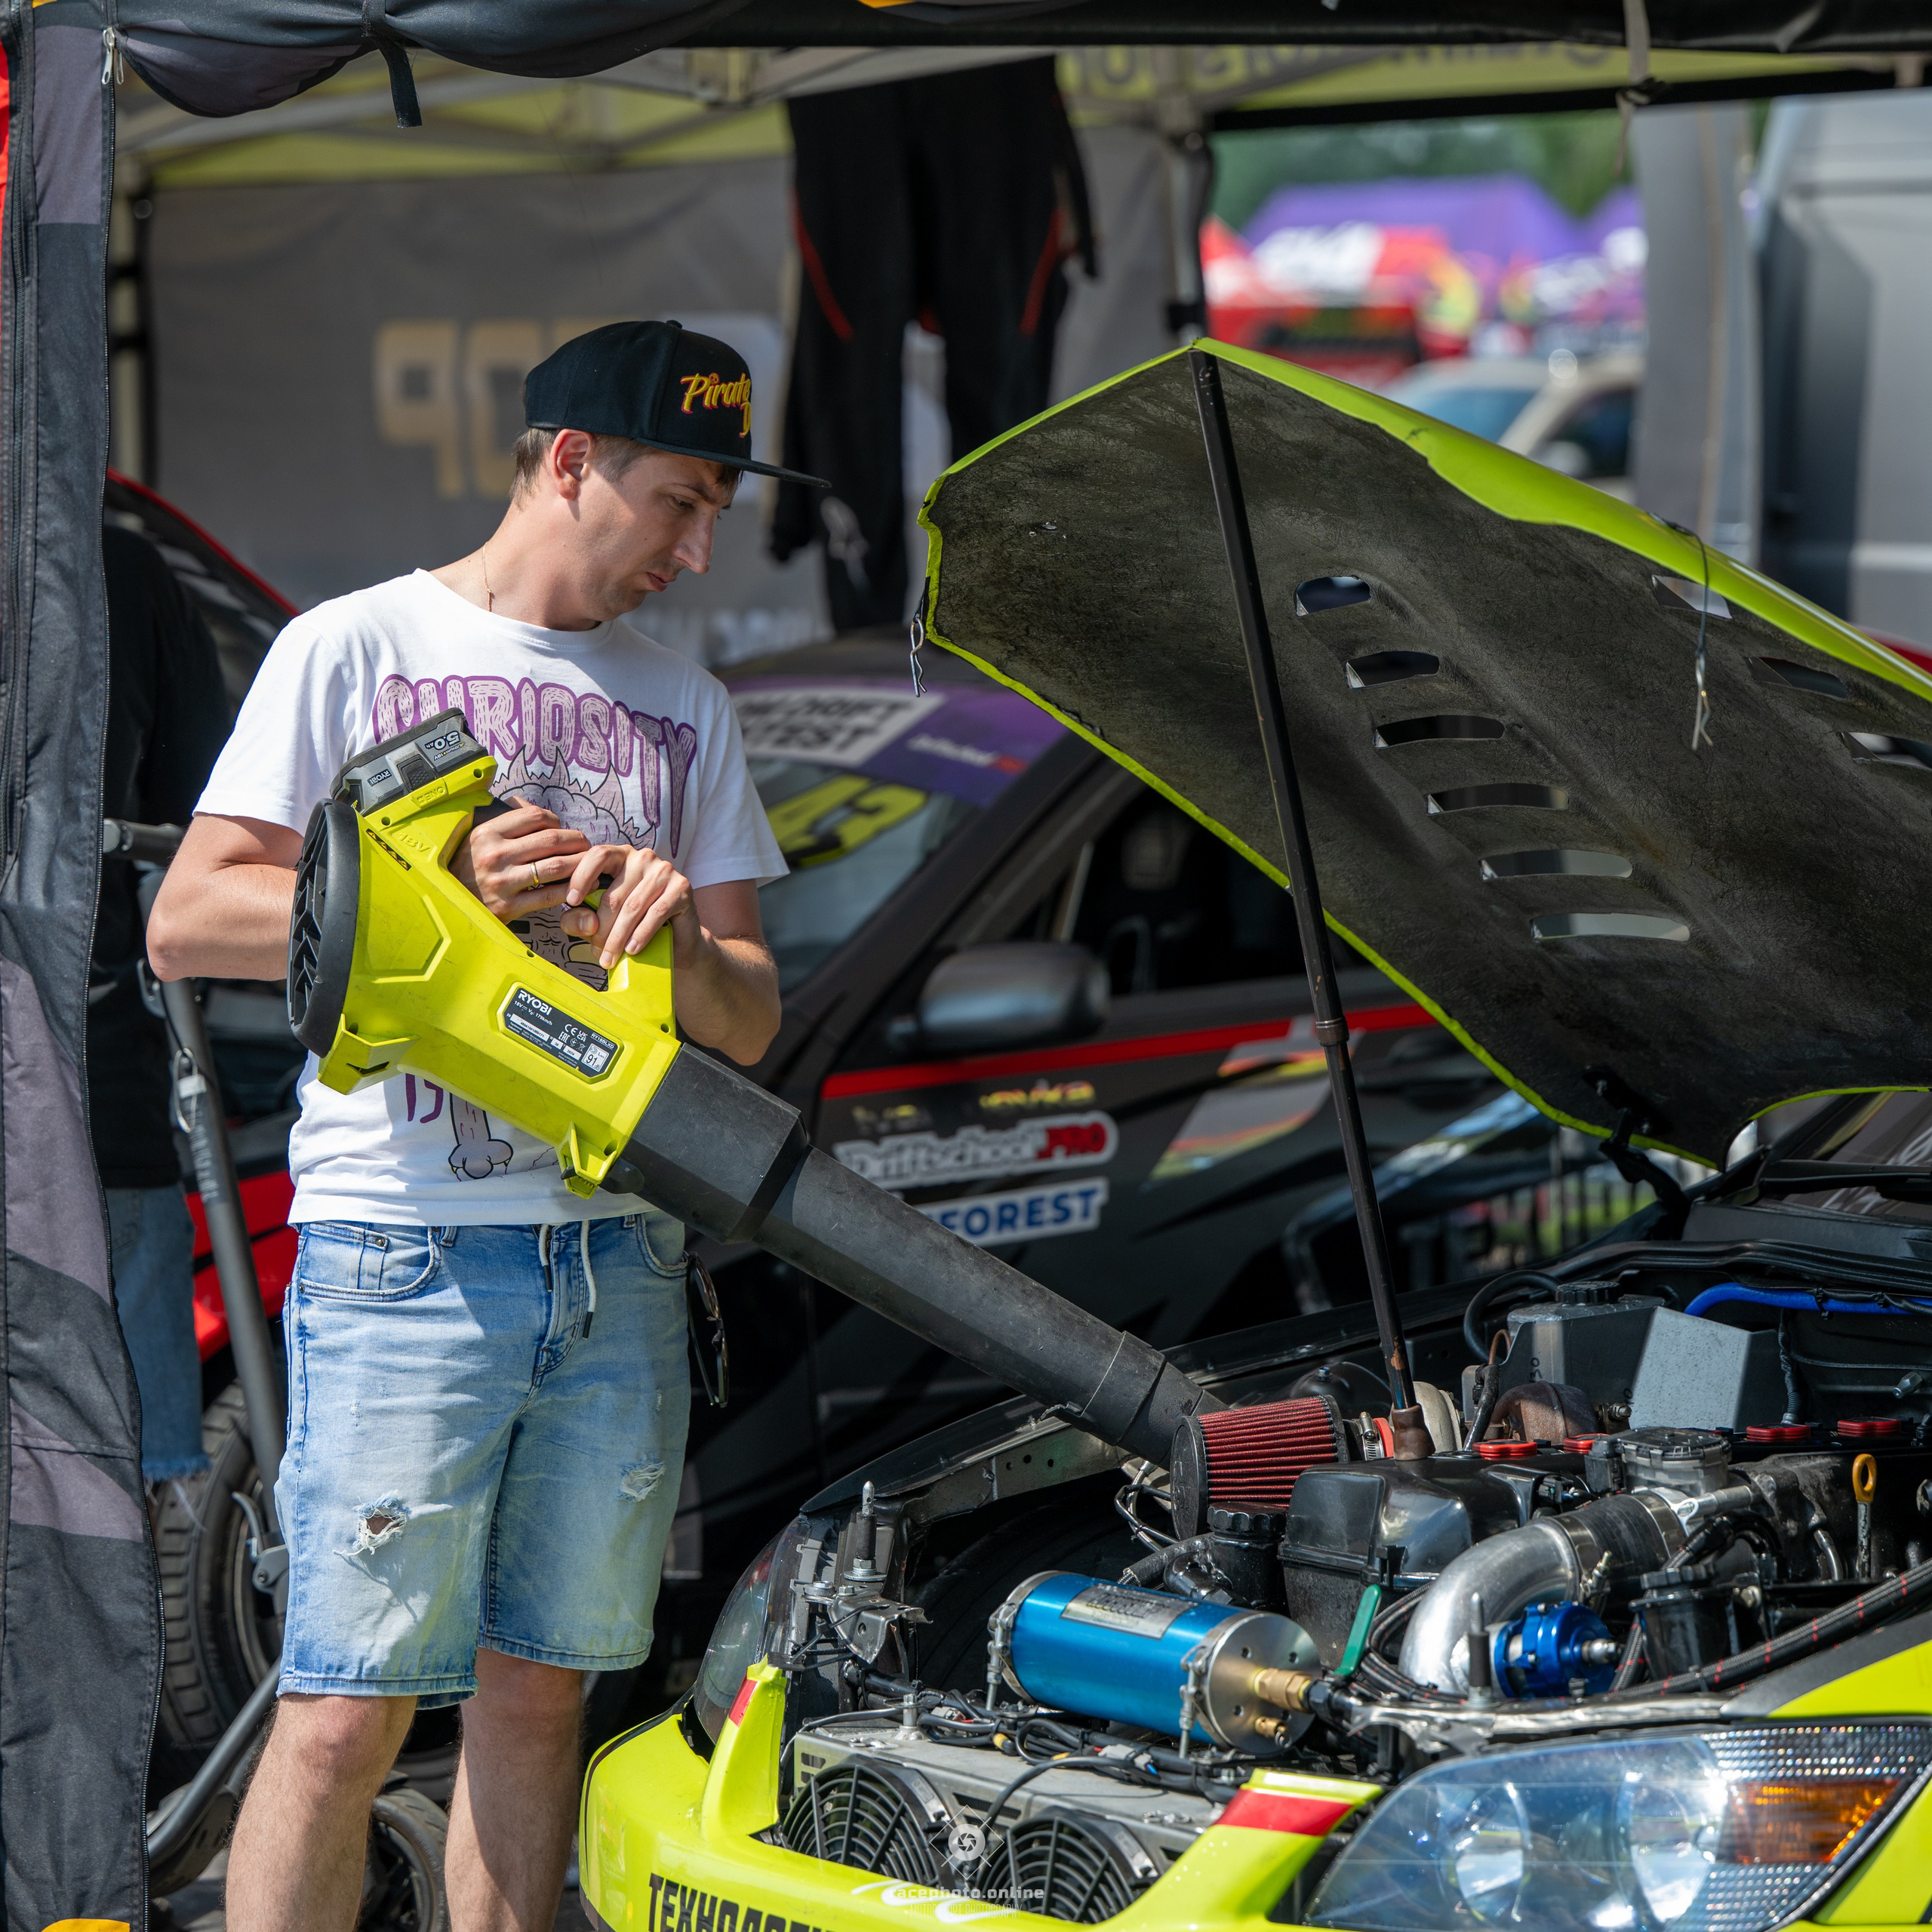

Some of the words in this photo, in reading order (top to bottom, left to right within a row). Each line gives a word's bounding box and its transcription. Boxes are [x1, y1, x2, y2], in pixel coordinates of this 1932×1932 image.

[369, 770, 390, 785] RYOBI
[372, 674, 697, 858] CURIOSITY
[398, 832, 430, 852] 18V
[518, 989, 552, 1016] RYOBI
[586, 1054, 598, 1066] 91
[927, 1189, 1099, 1236] FOREST
[648, 1872, 836, 1932] ТЕХНО
